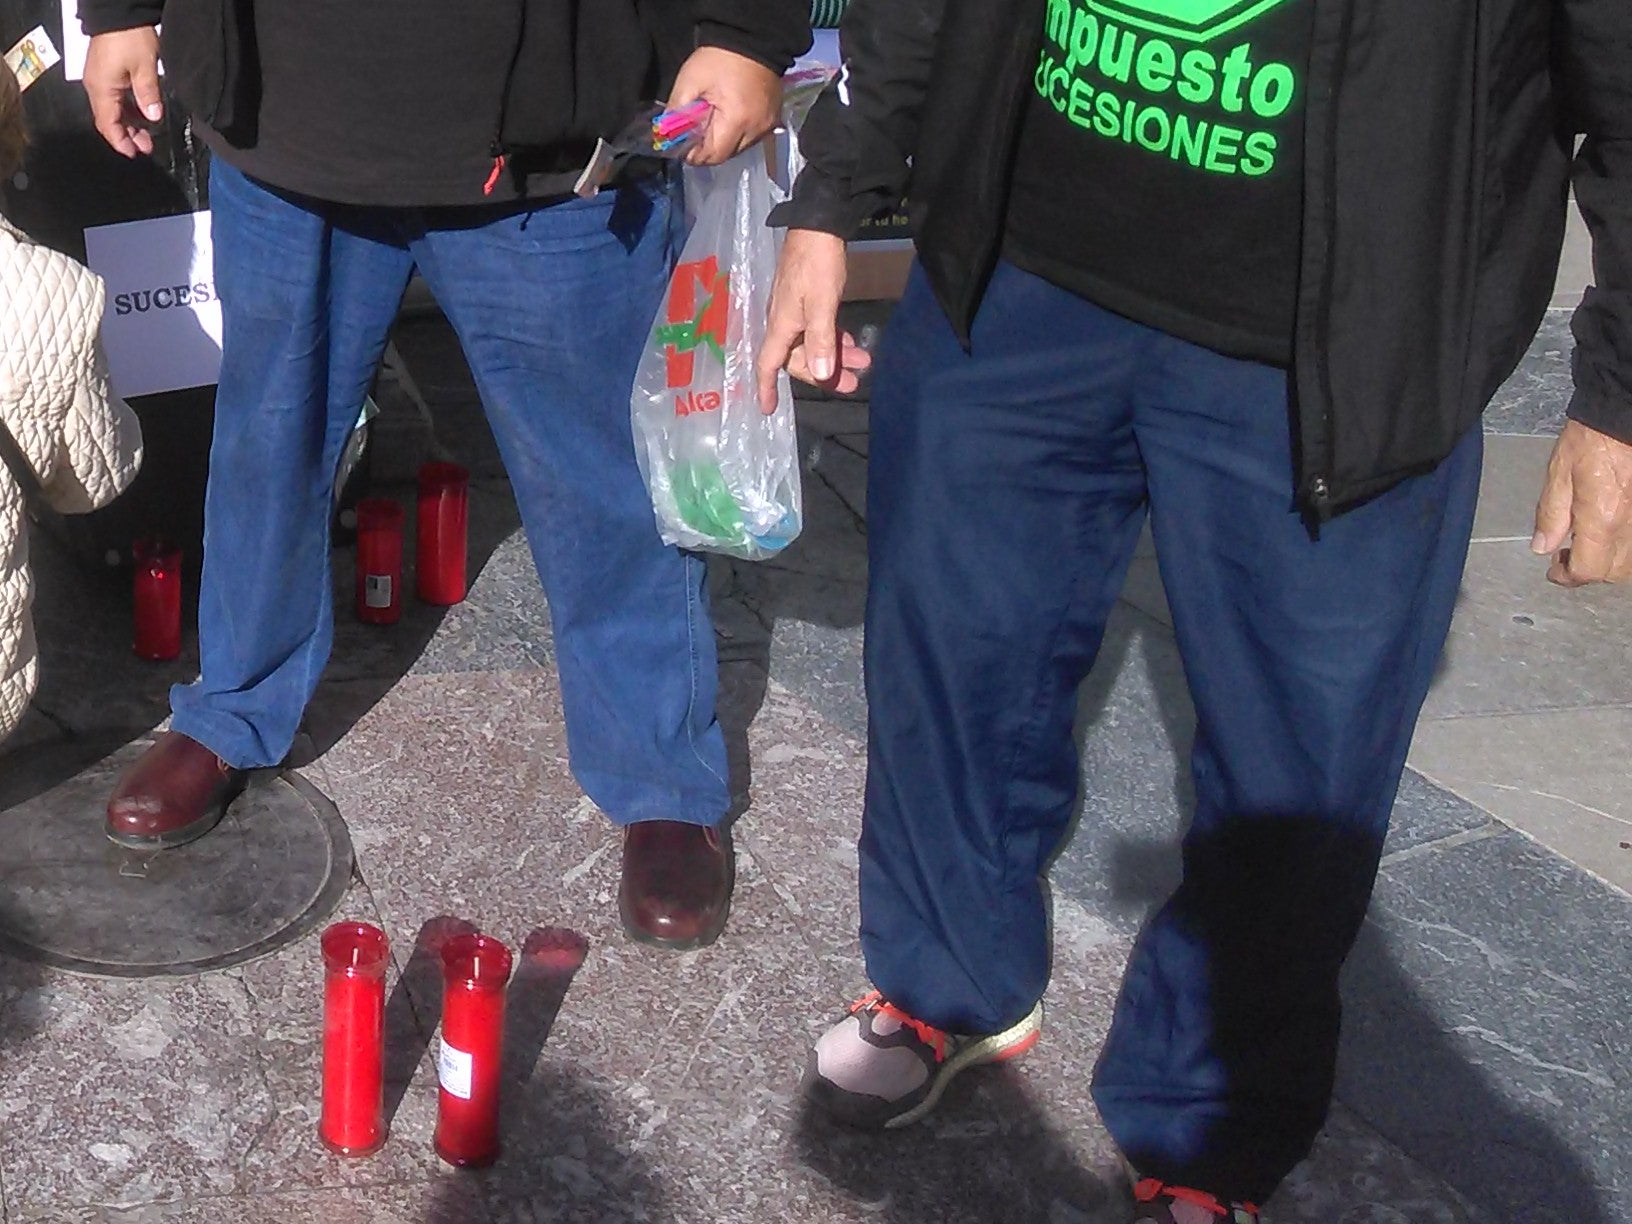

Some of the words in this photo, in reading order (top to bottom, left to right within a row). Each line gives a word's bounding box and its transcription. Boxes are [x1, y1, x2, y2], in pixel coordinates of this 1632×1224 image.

[1034, 50, 1279, 177] UCESIONES
[113, 281, 224, 316] SUCES
[675, 390, 722, 418] Alca
